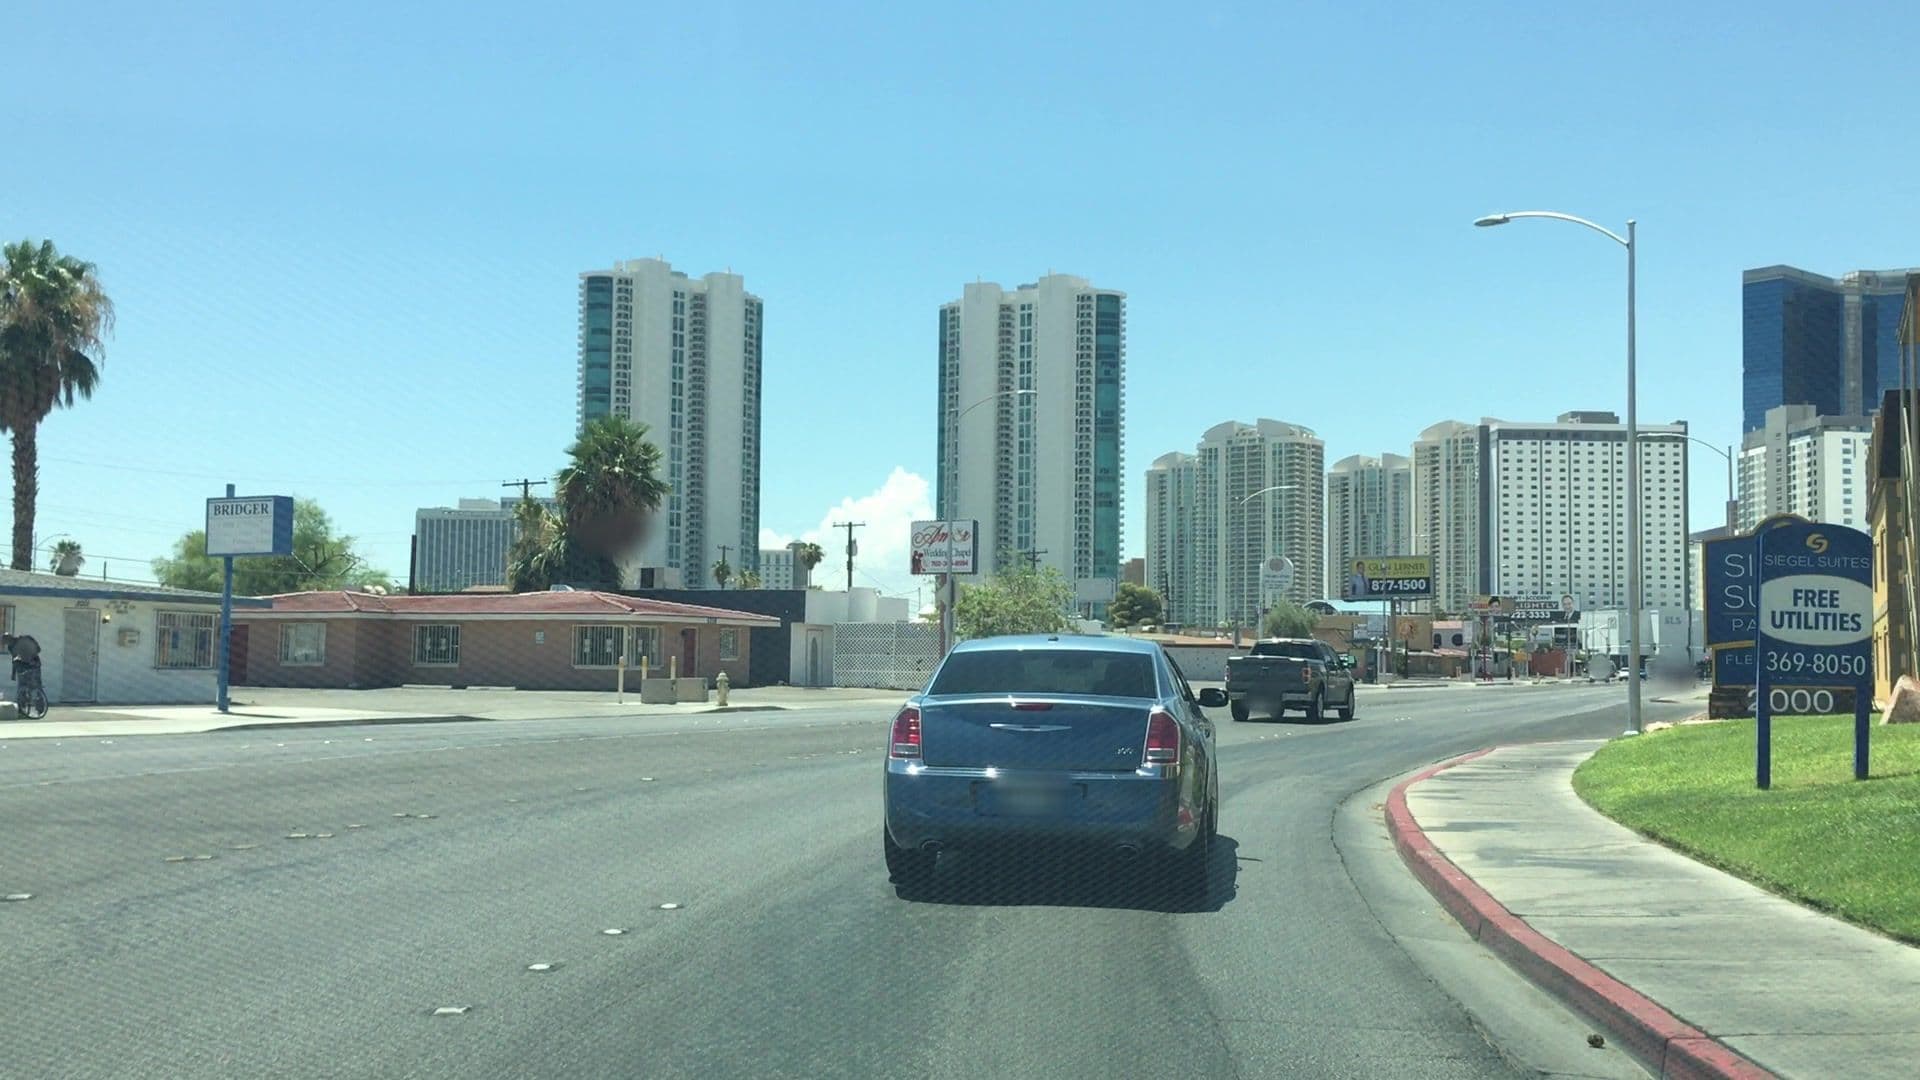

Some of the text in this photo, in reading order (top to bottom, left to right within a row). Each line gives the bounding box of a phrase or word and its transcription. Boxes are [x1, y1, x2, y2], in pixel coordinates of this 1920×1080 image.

[213, 503, 269, 516] BRIDGER
[1764, 554, 1871, 569] SIEGEL SUITES
[1371, 579, 1426, 591] 877-1500
[1792, 588, 1840, 608] FREE
[1771, 610, 1862, 632] UTILITIES
[1766, 651, 1866, 676] 369-8050
